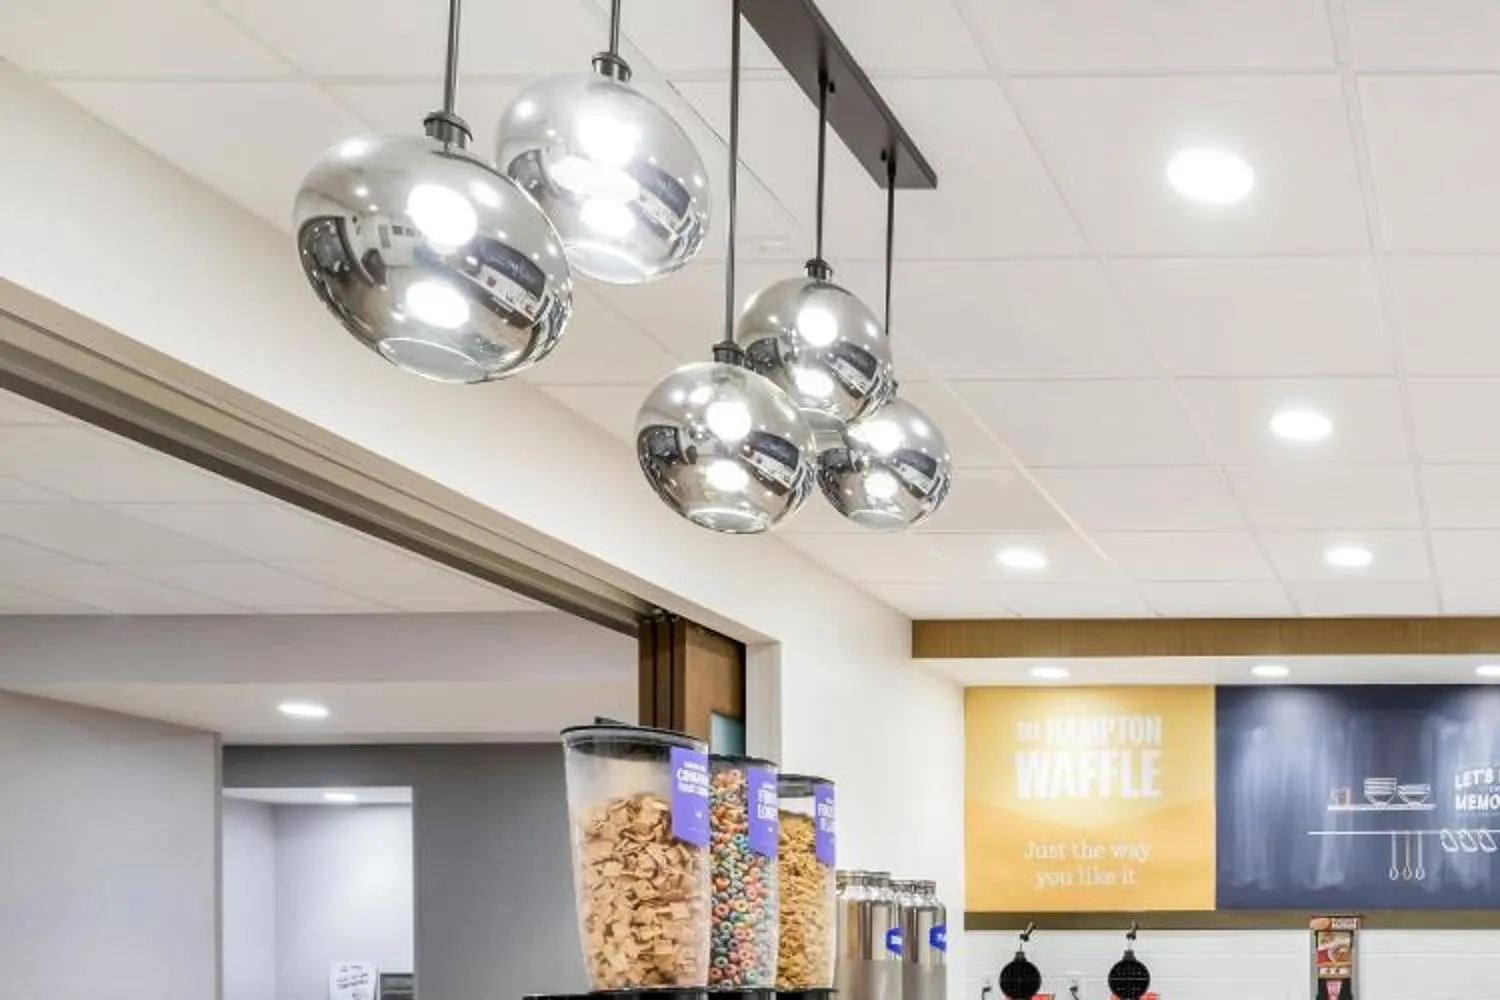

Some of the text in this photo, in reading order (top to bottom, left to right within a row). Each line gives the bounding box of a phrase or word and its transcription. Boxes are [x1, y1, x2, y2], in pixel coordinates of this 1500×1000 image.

[1046, 715, 1163, 745] HAMPTON
[1015, 750, 1163, 799] WAFFLE
[1455, 768, 1494, 789] LET'S
[1024, 839, 1153, 863] Just the way
[1035, 866, 1138, 890] you like it
